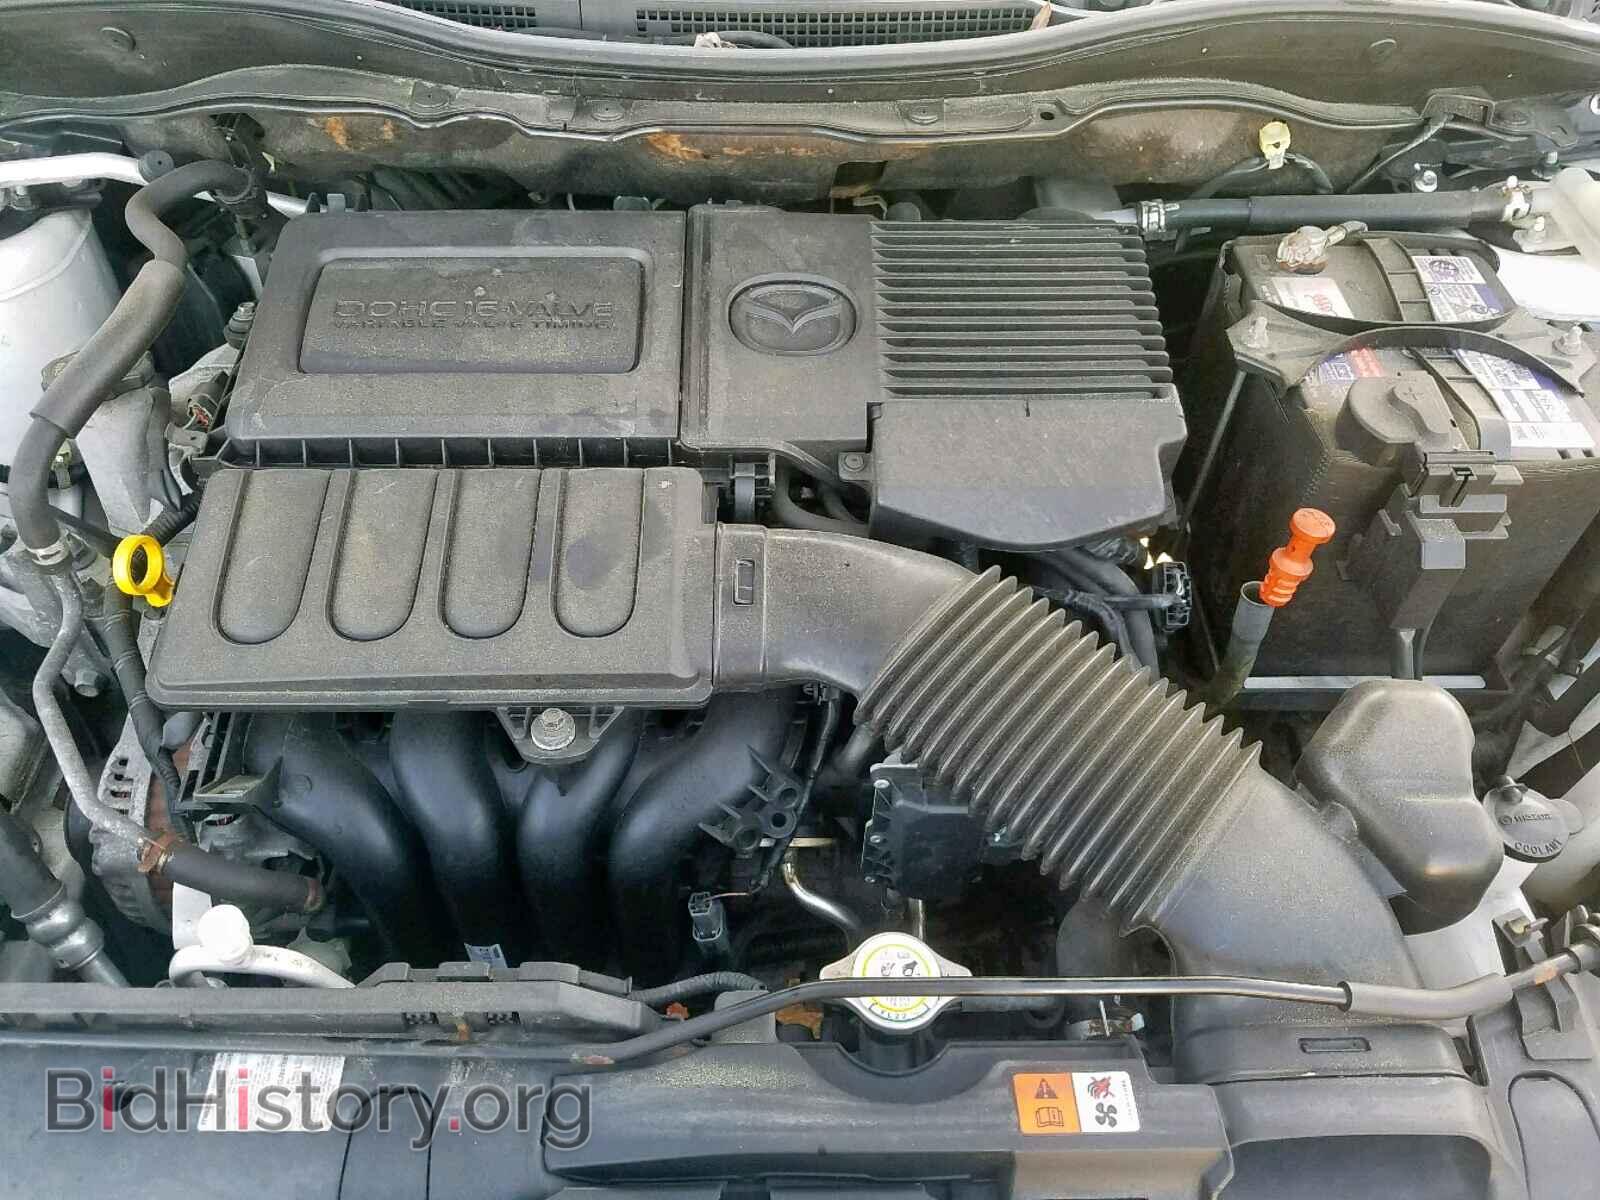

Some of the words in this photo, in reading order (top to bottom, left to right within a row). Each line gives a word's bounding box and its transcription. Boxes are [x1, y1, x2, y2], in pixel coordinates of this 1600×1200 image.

[335, 299, 457, 317] DOHC
[463, 300, 614, 317] 16-VALVE
[1514, 838, 1562, 855] COOLANT
